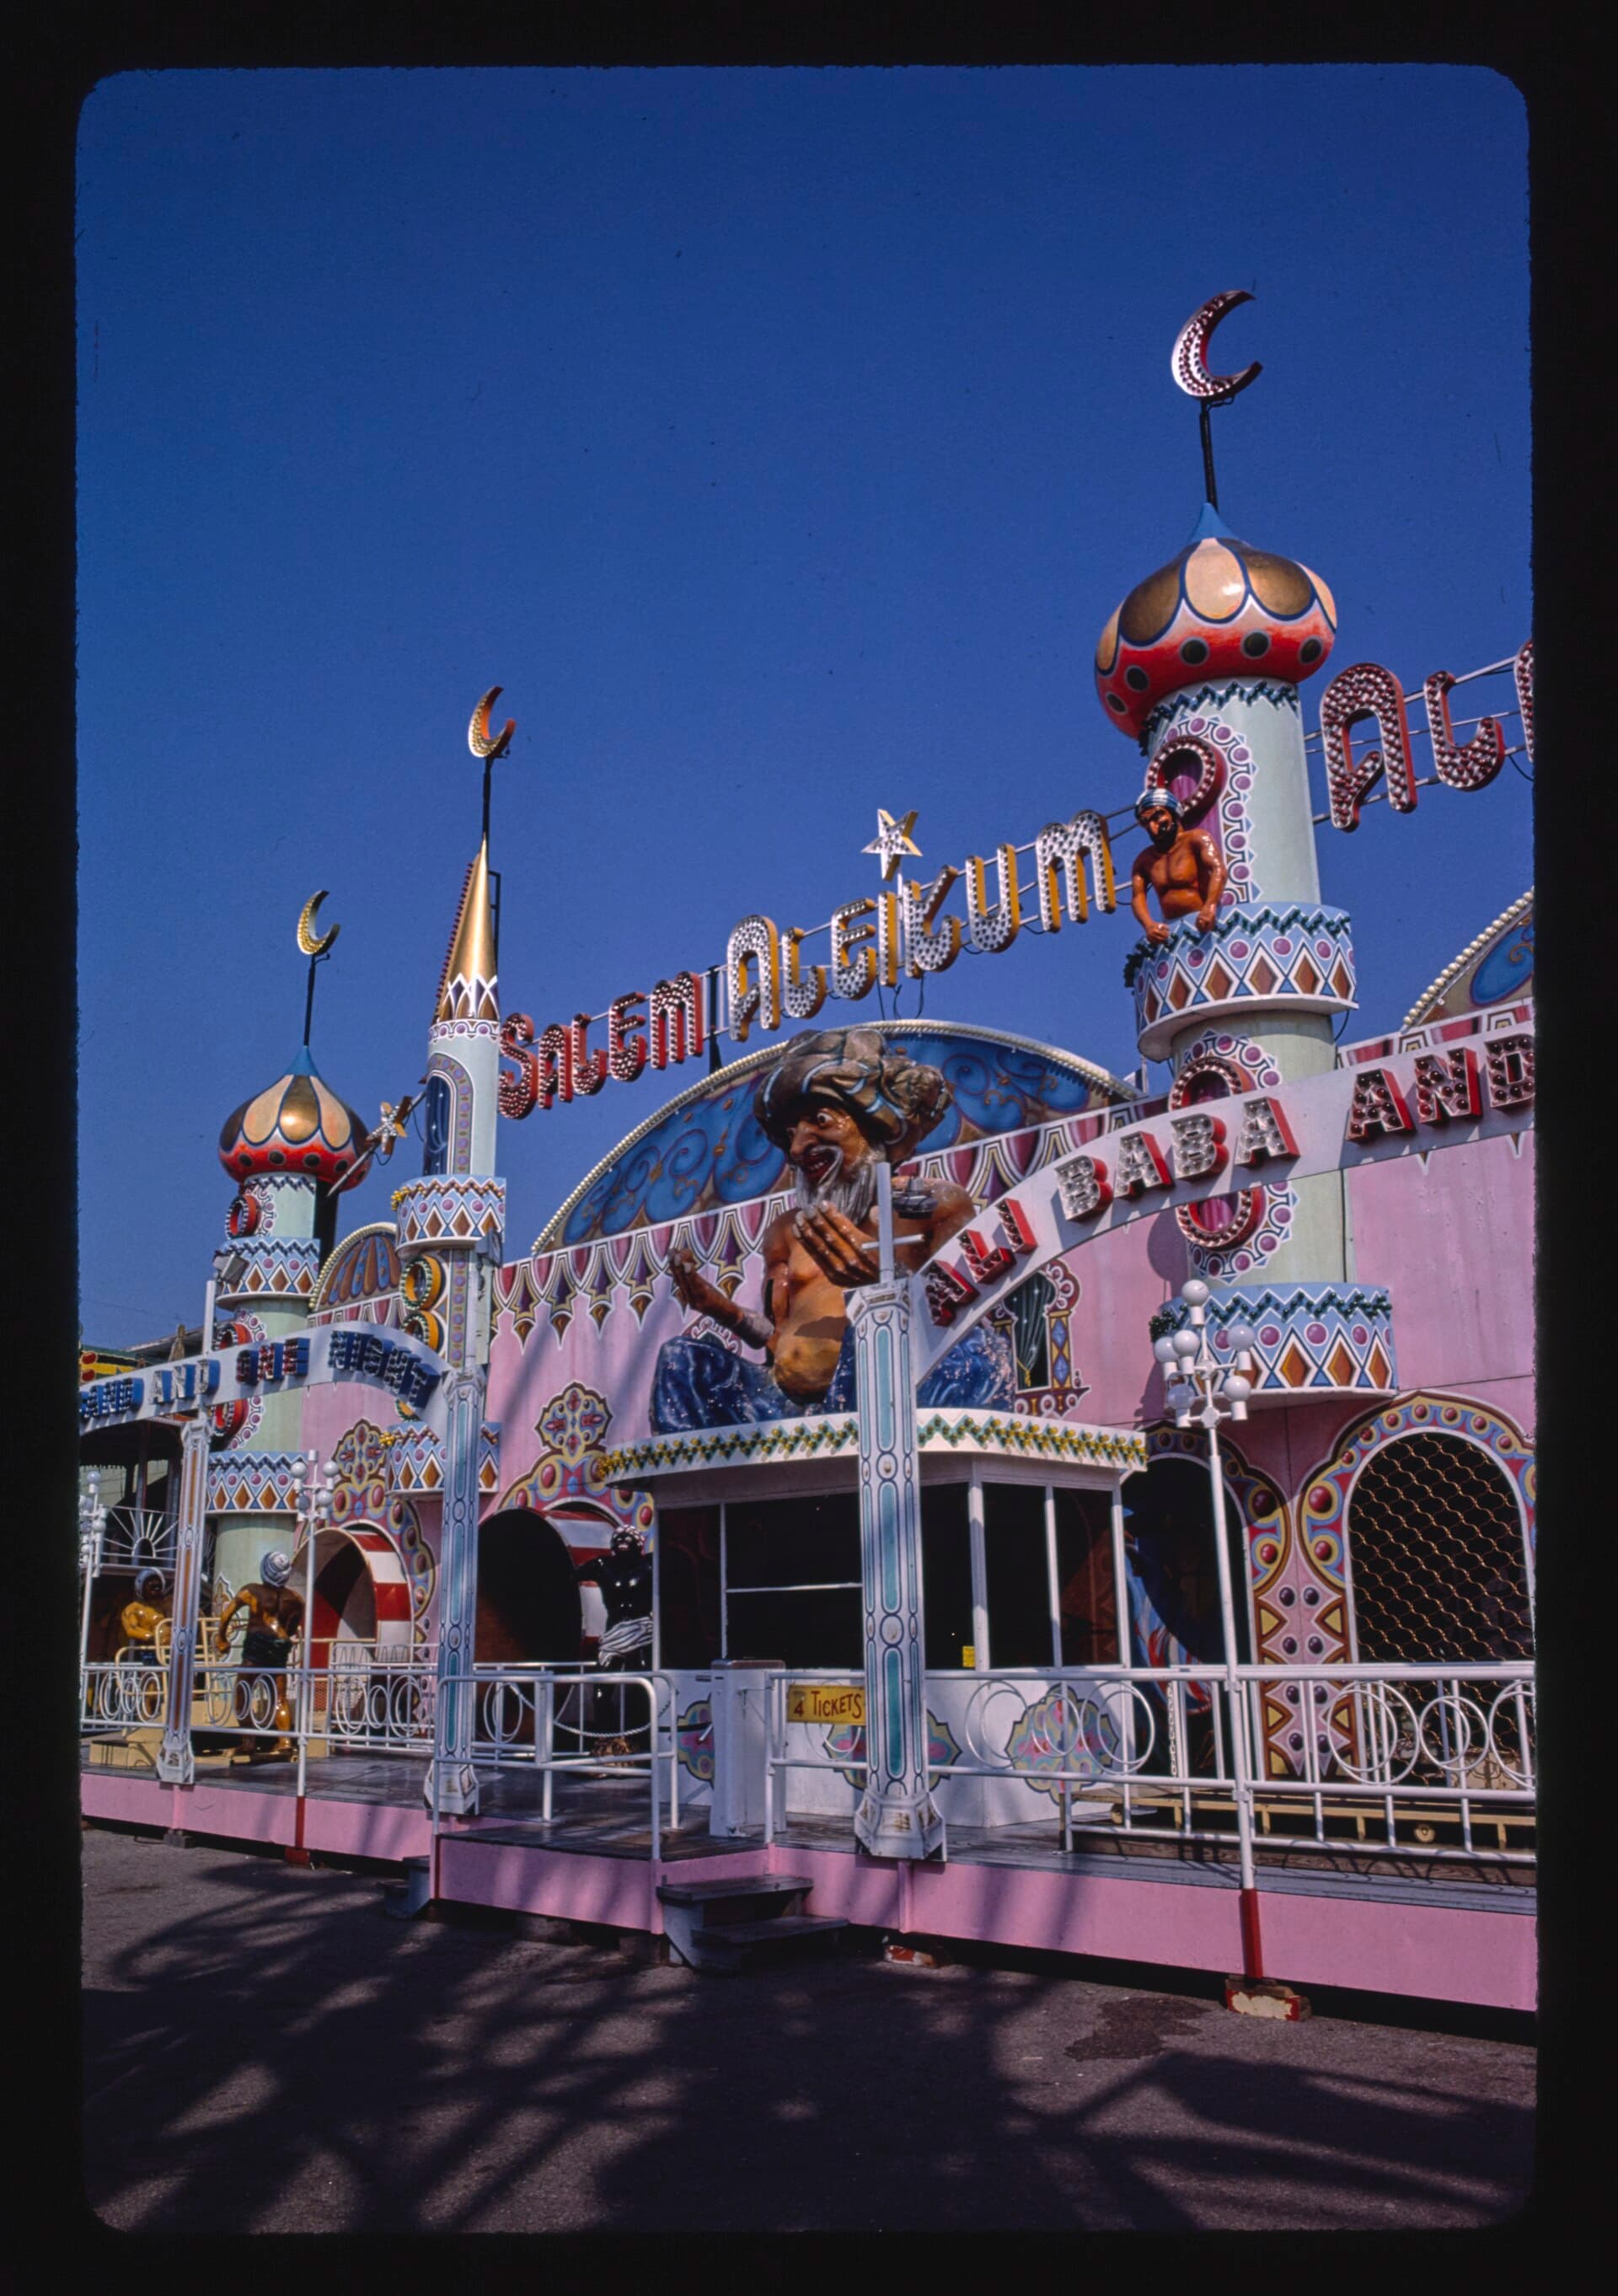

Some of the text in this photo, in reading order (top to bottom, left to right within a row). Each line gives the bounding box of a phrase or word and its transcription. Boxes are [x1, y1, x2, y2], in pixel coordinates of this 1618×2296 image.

[1320, 638, 1535, 832] AL
[498, 809, 1117, 1119] SALEM ALEIKUM
[924, 1033, 1535, 1327] ALI BABA AND
[150, 1359, 221, 1405] AND
[236, 1337, 310, 1386] ONE
[329, 1330, 441, 1409] NIGHT
[794, 1690, 862, 1719] 4 TICKETS
